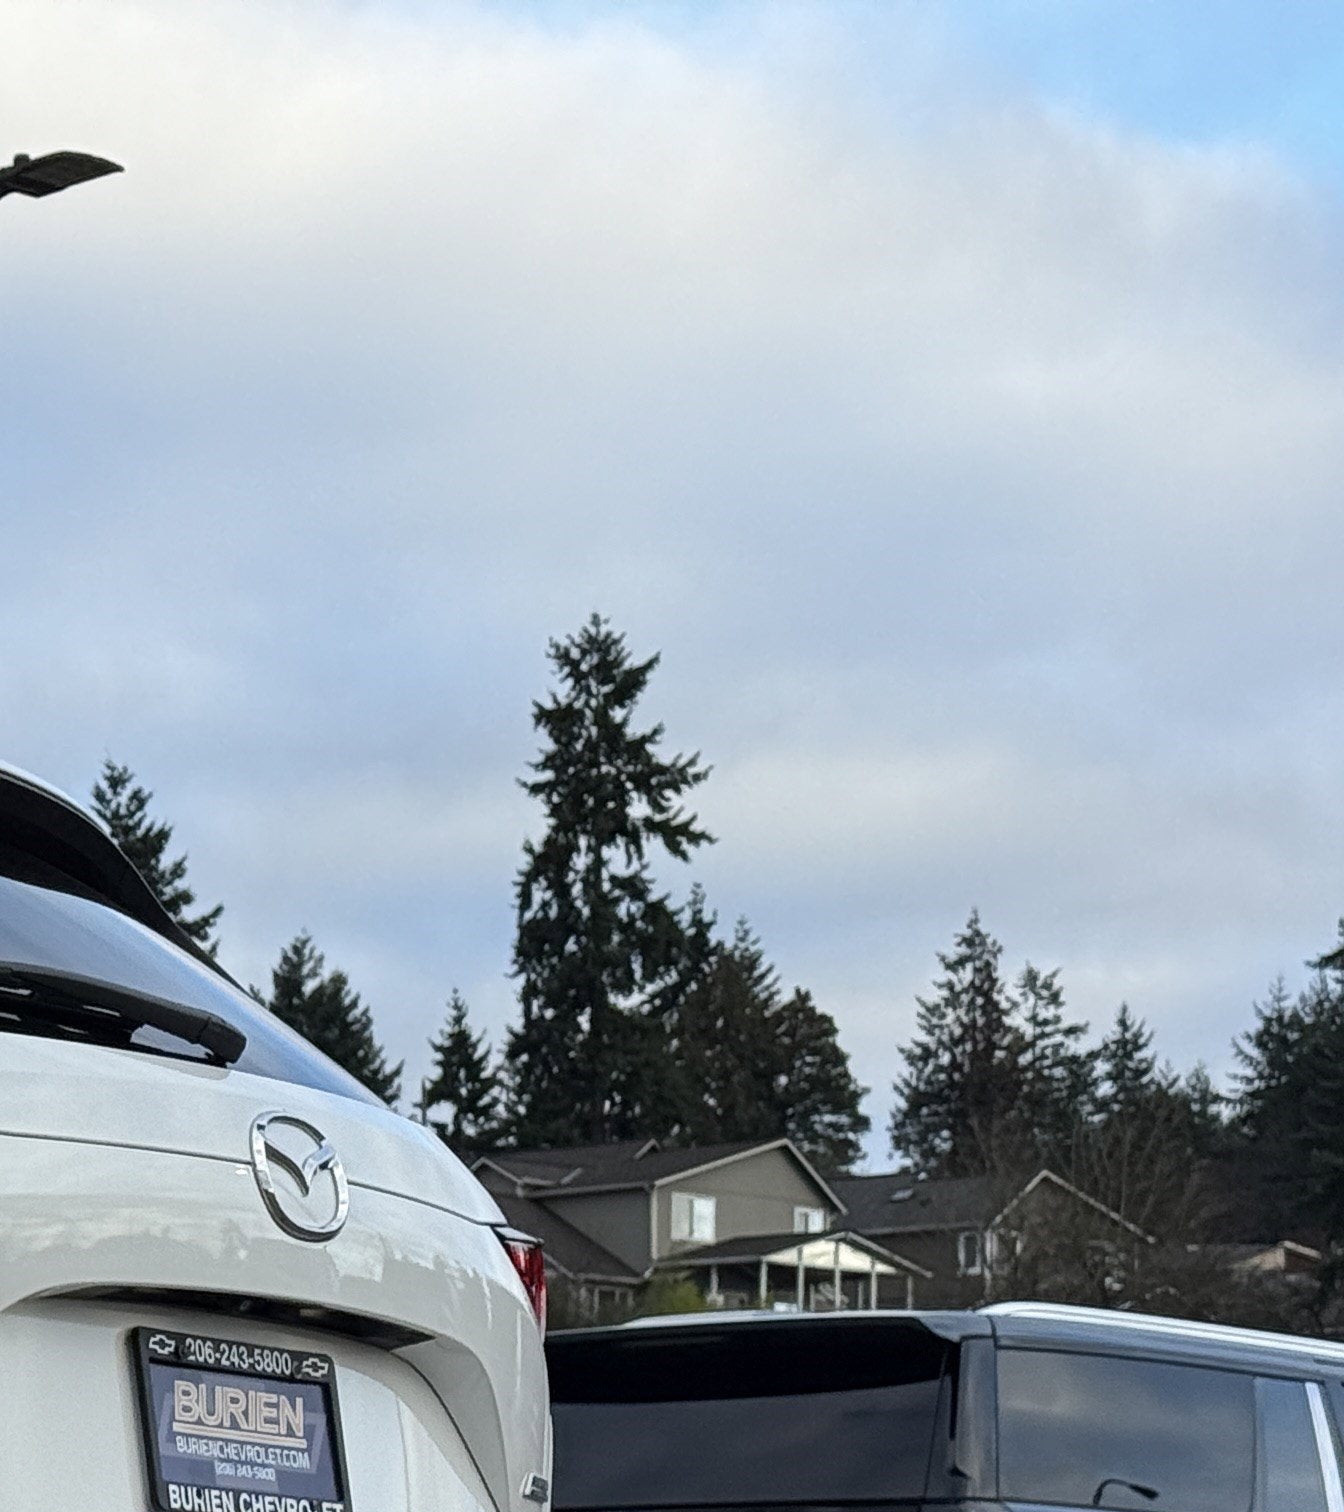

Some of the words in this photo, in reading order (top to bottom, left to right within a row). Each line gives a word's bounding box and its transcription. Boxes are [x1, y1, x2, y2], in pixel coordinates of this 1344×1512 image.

[185, 1338, 292, 1375] 206-243-5800
[174, 1380, 304, 1437] BURIEN
[175, 1436, 310, 1469] BURIENCHEVROLET.COM
